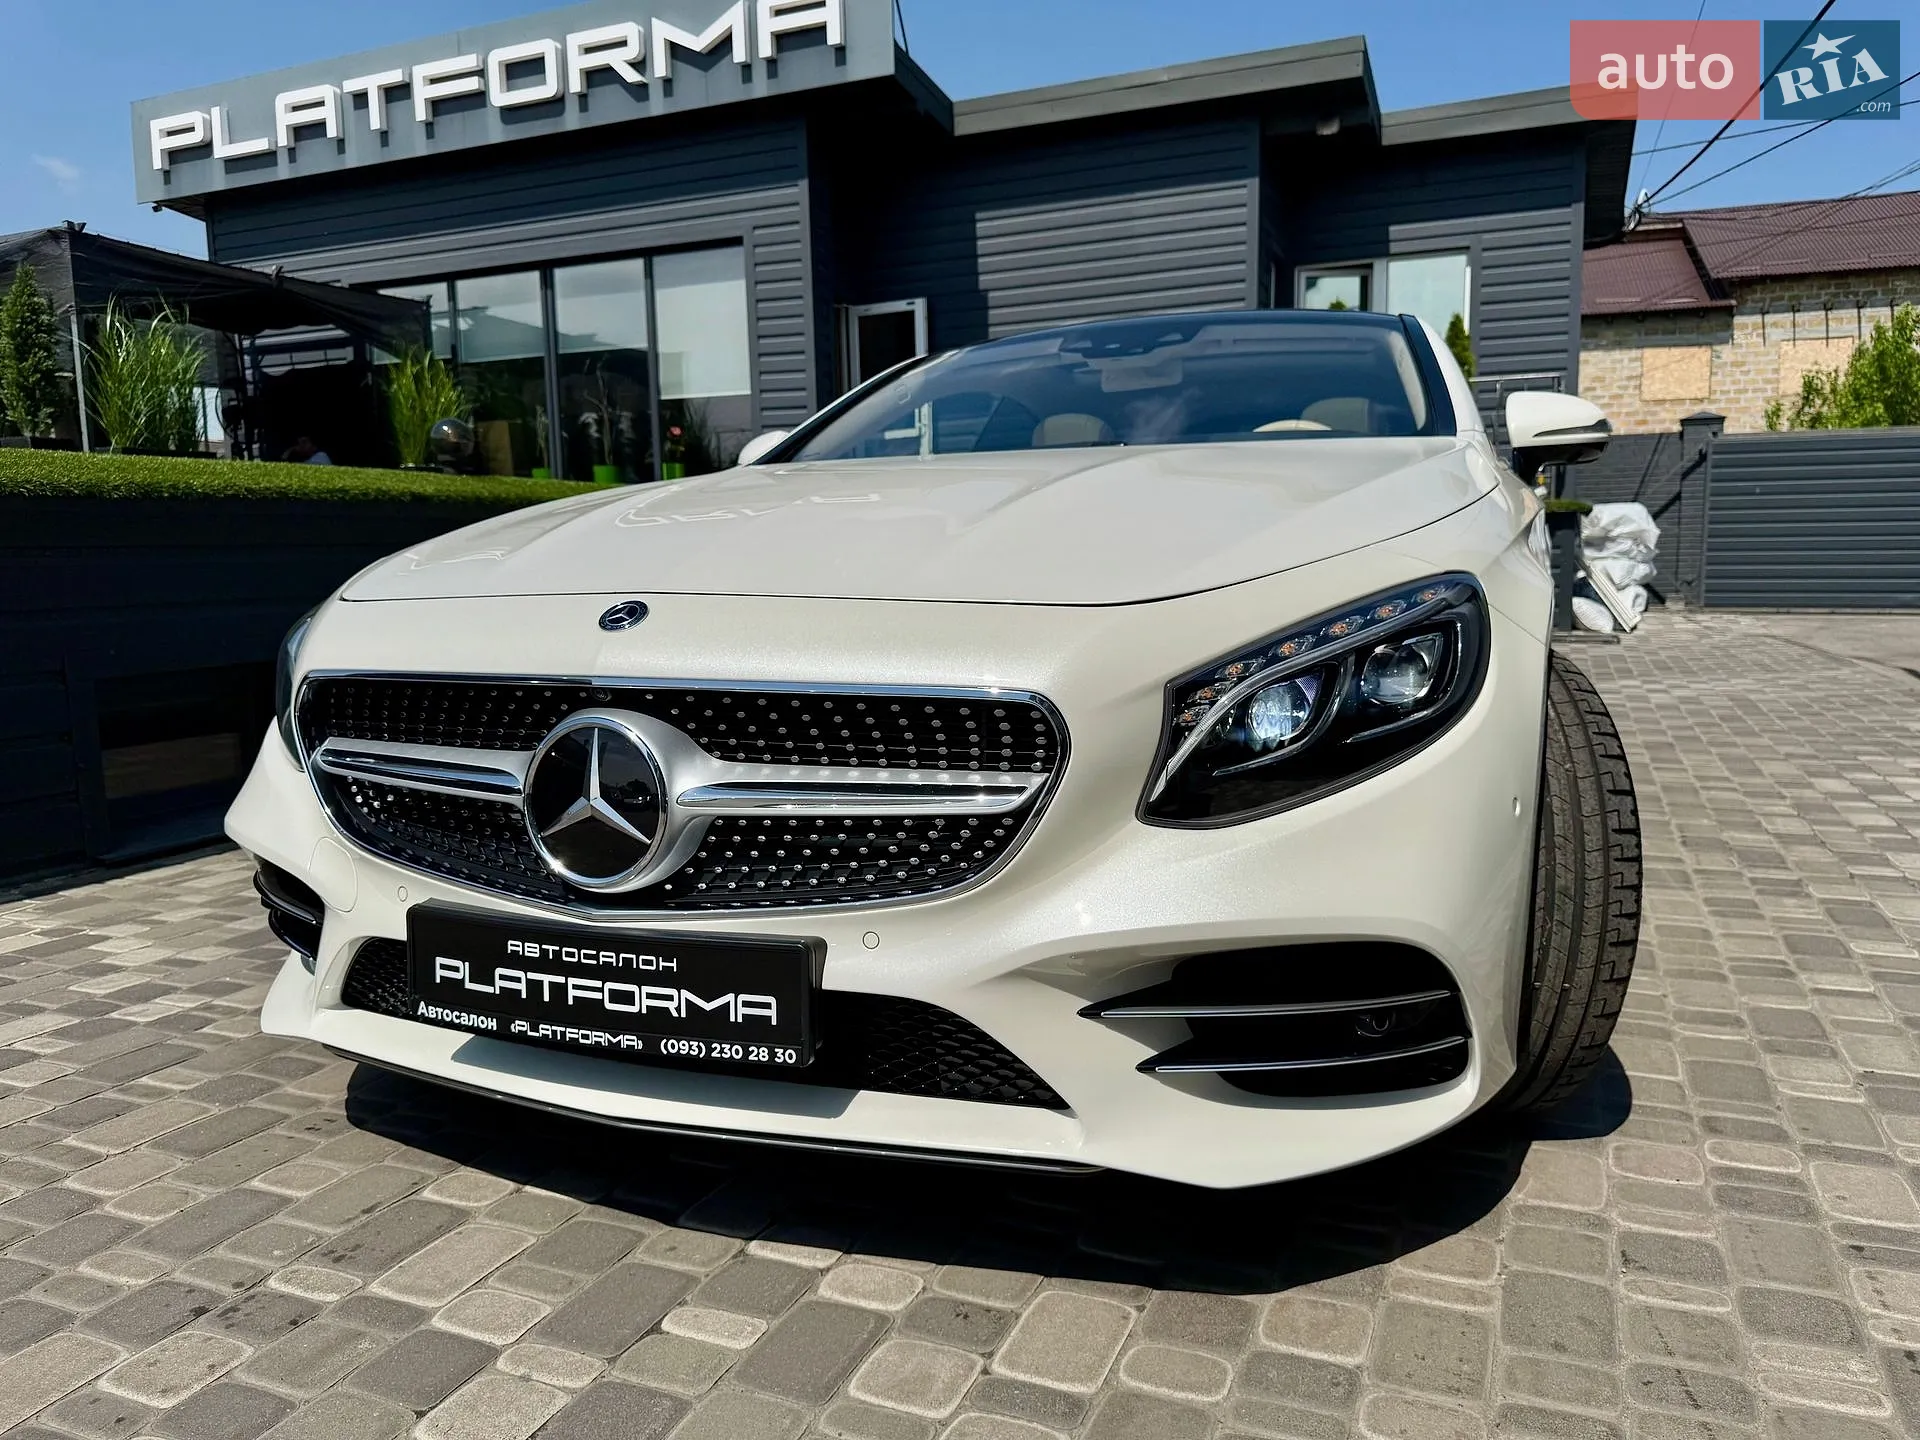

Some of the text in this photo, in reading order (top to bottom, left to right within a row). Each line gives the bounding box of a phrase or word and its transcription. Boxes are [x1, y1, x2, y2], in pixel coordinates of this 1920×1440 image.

[149, 0, 846, 171] PLATFORMA
[507, 940, 677, 972] АВТОСАЛОН
[435, 956, 777, 1025] PLATFORMA
[417, 1000, 498, 1031] Автосалон
[660, 1038, 706, 1058] (093)
[710, 1042, 743, 1060] 230
[748, 1046, 769, 1062] 28
[774, 1048, 797, 1064] 30
